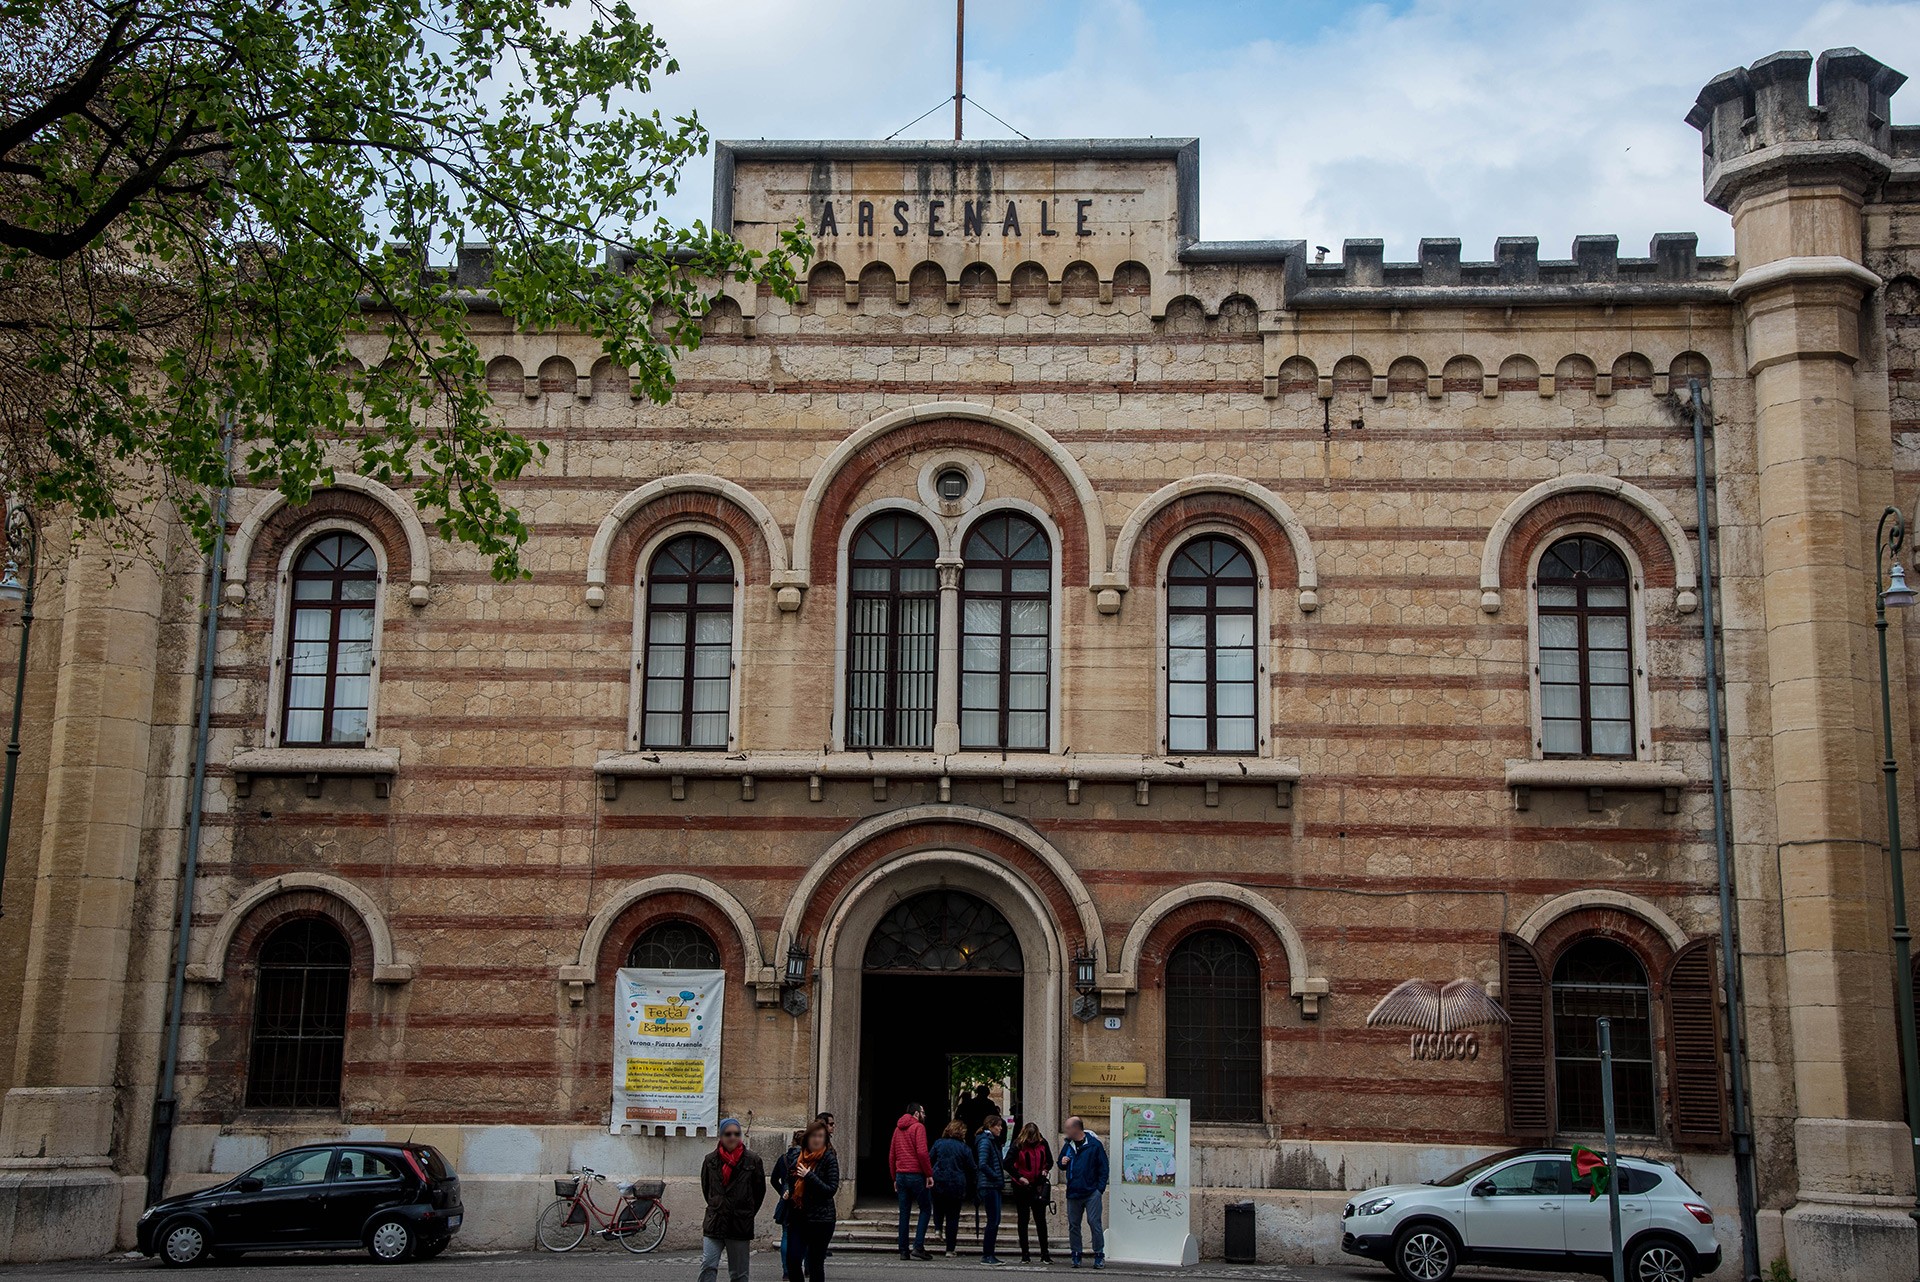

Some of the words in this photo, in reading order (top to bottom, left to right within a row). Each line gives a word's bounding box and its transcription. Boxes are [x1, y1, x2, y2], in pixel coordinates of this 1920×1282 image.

[819, 200, 1094, 237] ARSENALE
[648, 1007, 683, 1019] Festa
[643, 1022, 689, 1033] Bambino
[1109, 1018, 1117, 1028] 8
[629, 1039, 651, 1047] Verona
